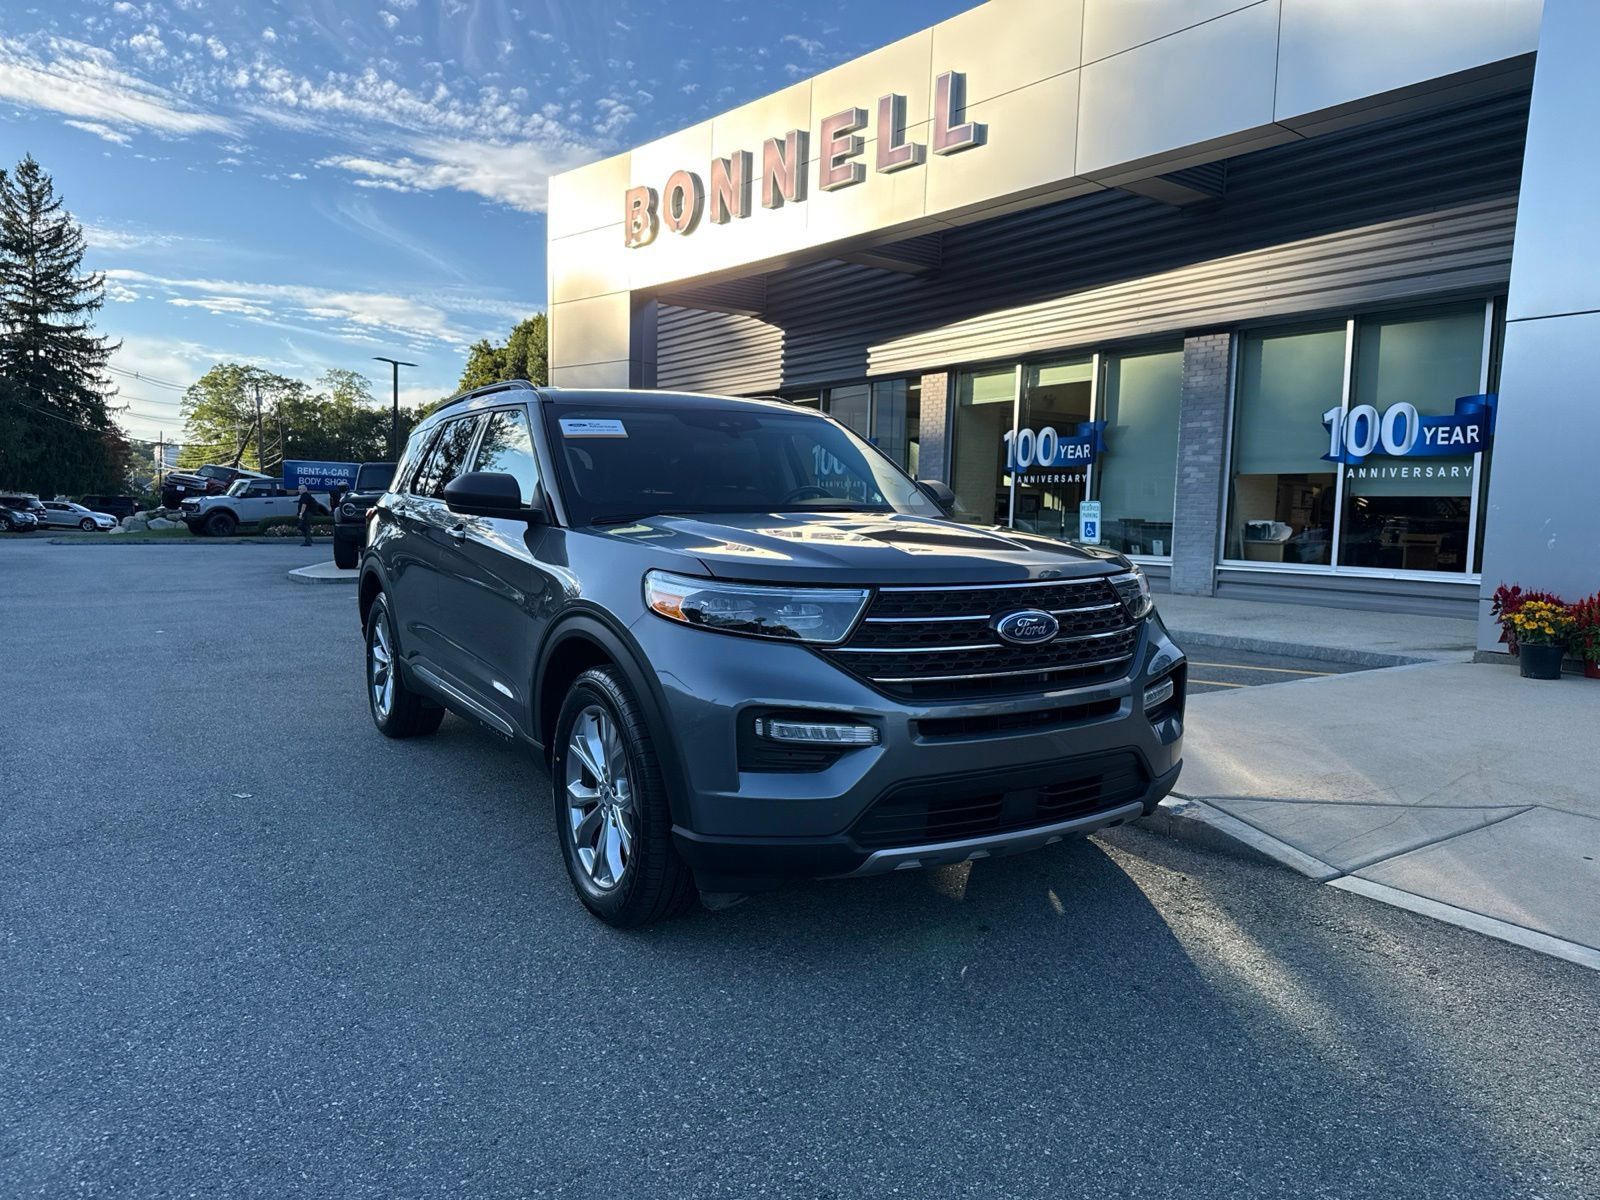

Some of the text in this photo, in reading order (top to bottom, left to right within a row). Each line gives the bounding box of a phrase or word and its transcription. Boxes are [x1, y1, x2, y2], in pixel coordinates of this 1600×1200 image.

[625, 70, 988, 248] BONNELL
[1323, 401, 1480, 457] 100 YEAR
[1003, 426, 1091, 468] 100 YEAR
[297, 467, 349, 477] RENT-A-CAR
[1017, 474, 1087, 484] ANNIVERSARY
[1347, 466, 1473, 479] ANNIVERSARY
[298, 477, 321, 486] BODY
[1014, 617, 1047, 637] Ford
